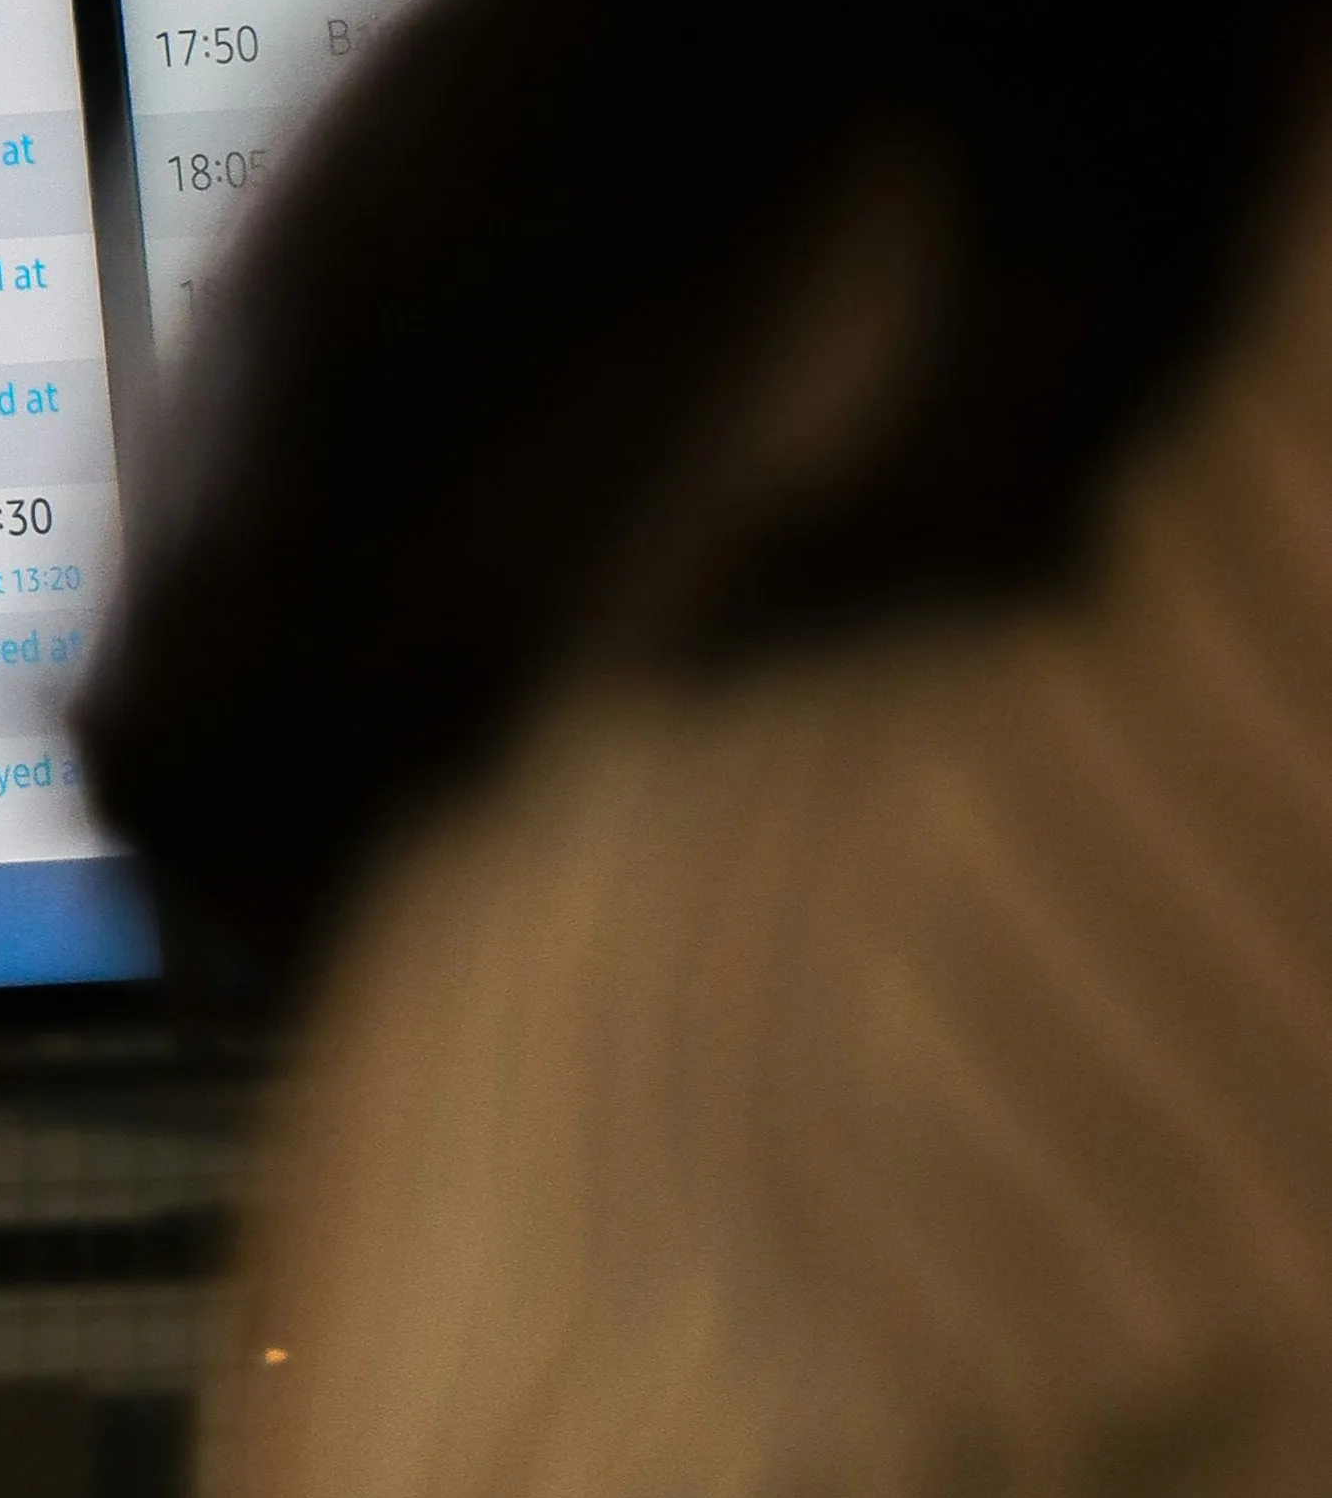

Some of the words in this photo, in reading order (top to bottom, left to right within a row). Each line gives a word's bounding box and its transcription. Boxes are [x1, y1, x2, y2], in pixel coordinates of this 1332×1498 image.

[1, 132, 36, 168] at
[13, 258, 49, 292] at
[25, 381, 60, 416] at
[12, 565, 82, 593] 13:20
